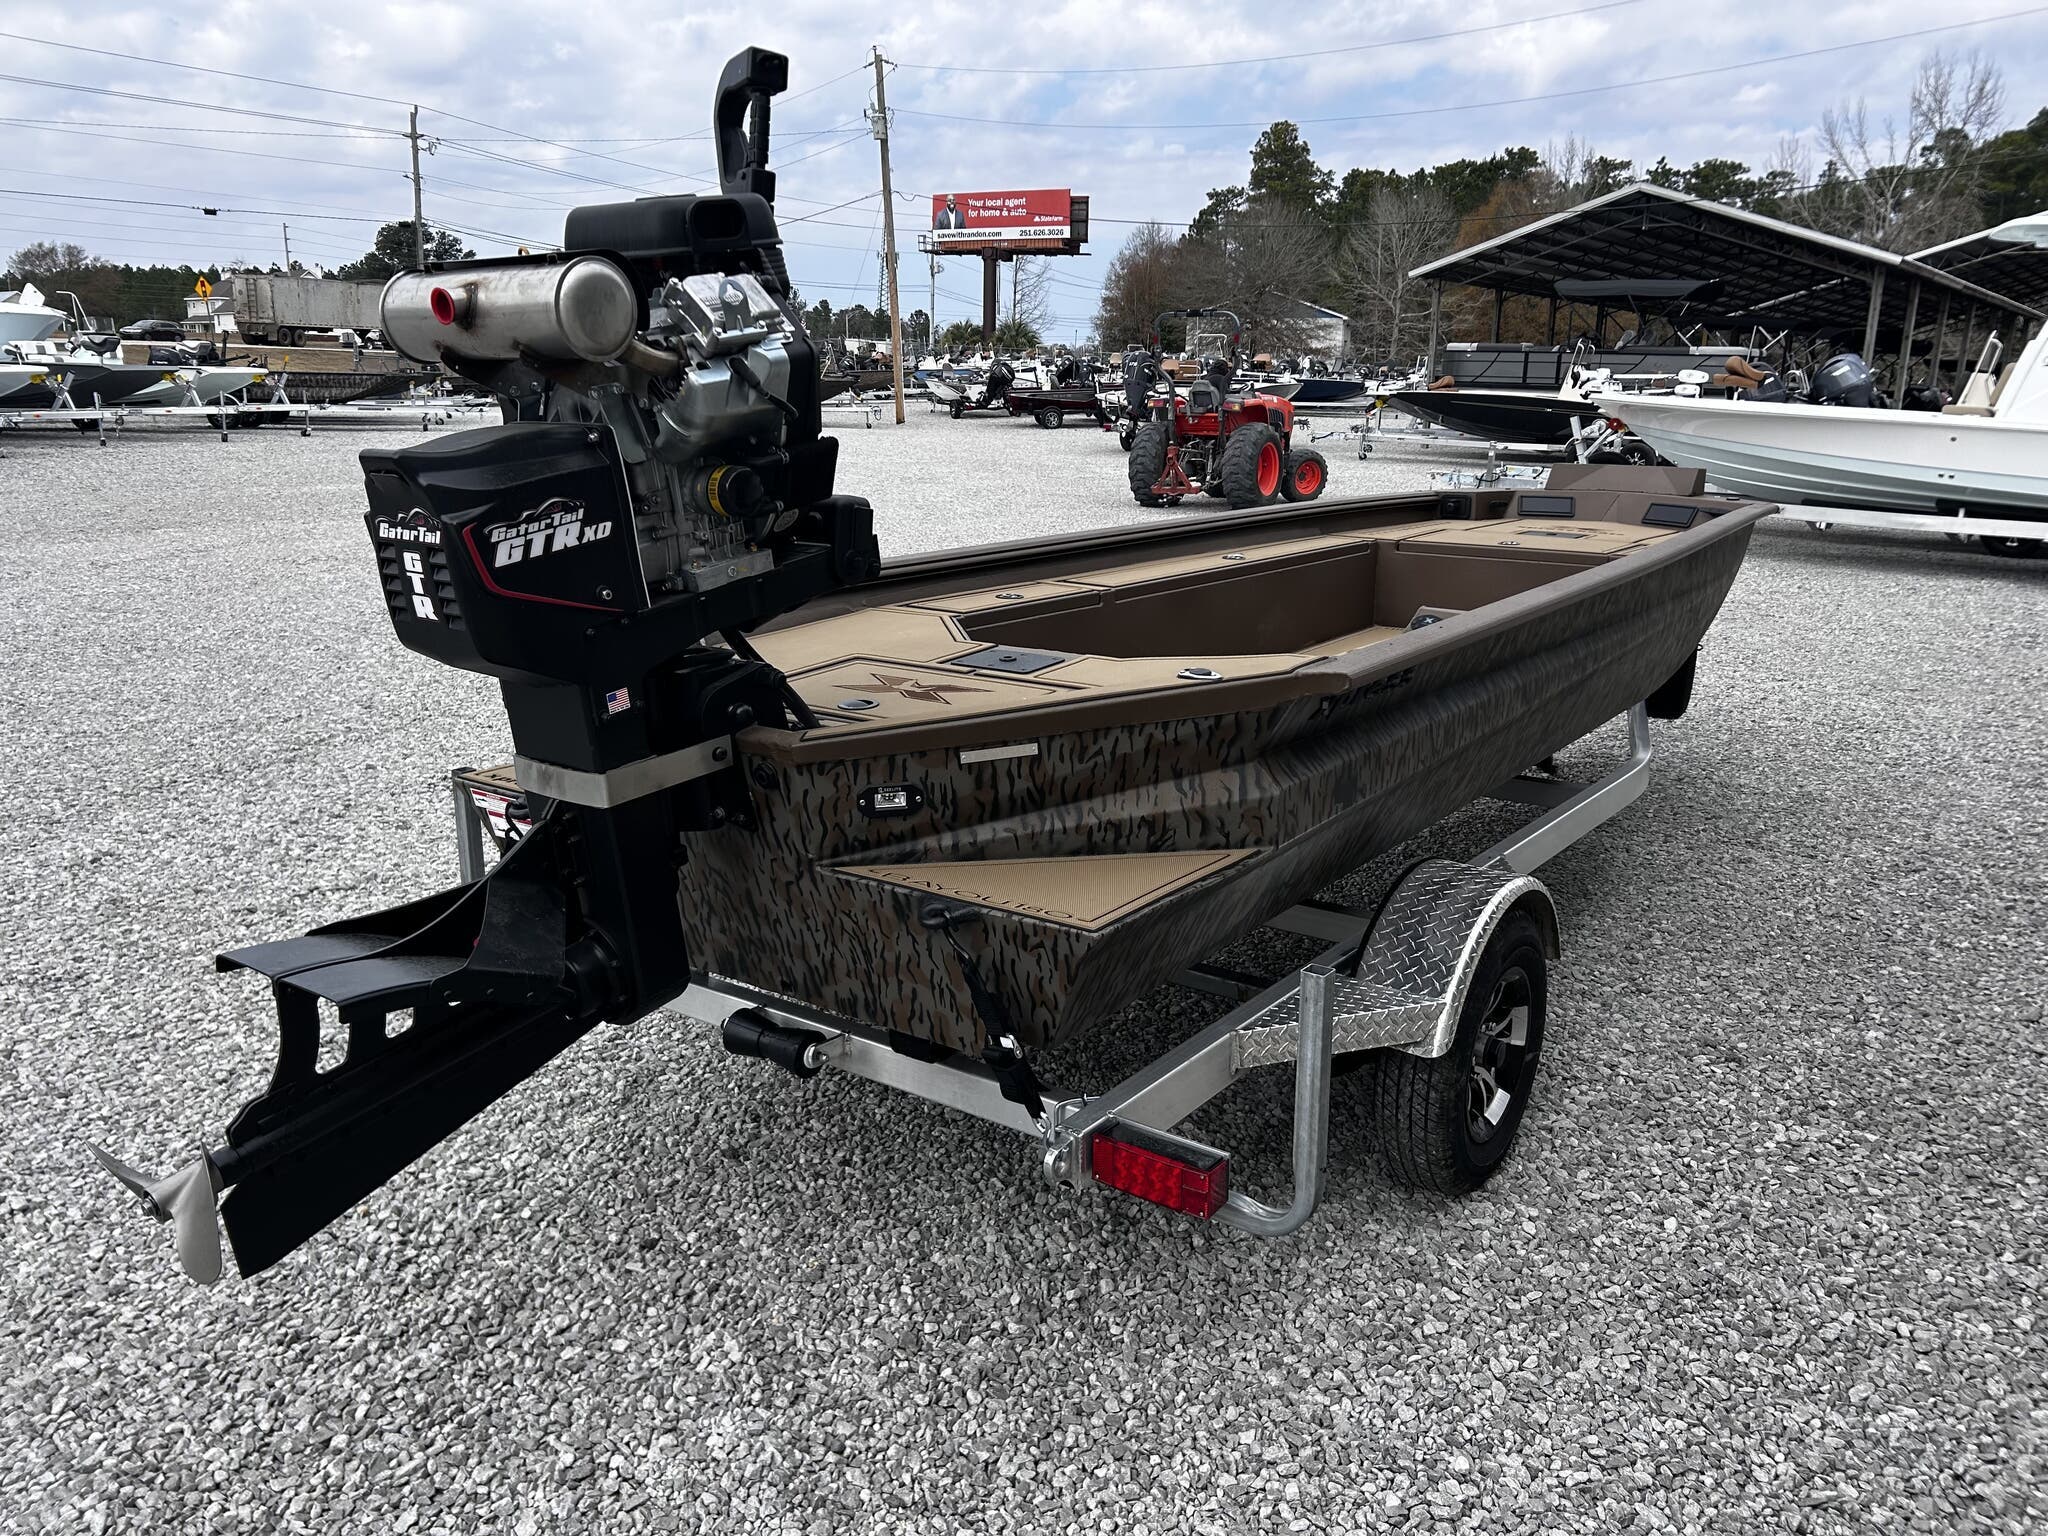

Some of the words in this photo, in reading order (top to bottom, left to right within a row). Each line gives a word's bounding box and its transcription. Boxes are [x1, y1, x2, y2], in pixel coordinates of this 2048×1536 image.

[968, 198, 983, 207] Your
[985, 198, 1003, 207] local
[1005, 197, 1026, 207] agent
[968, 209, 978, 217] for
[980, 208, 1000, 217] home
[1002, 208, 1008, 216] &
[1010, 208, 1027, 216] auto
[937, 230, 1002, 239] savewithrandon.com
[1019, 229, 1064, 237] 251.626.3026
[379, 522, 441, 545] GatorTail
[490, 508, 584, 543] GatorTail
[494, 521, 583, 568] GTR
[403, 551, 439, 621] GTR
